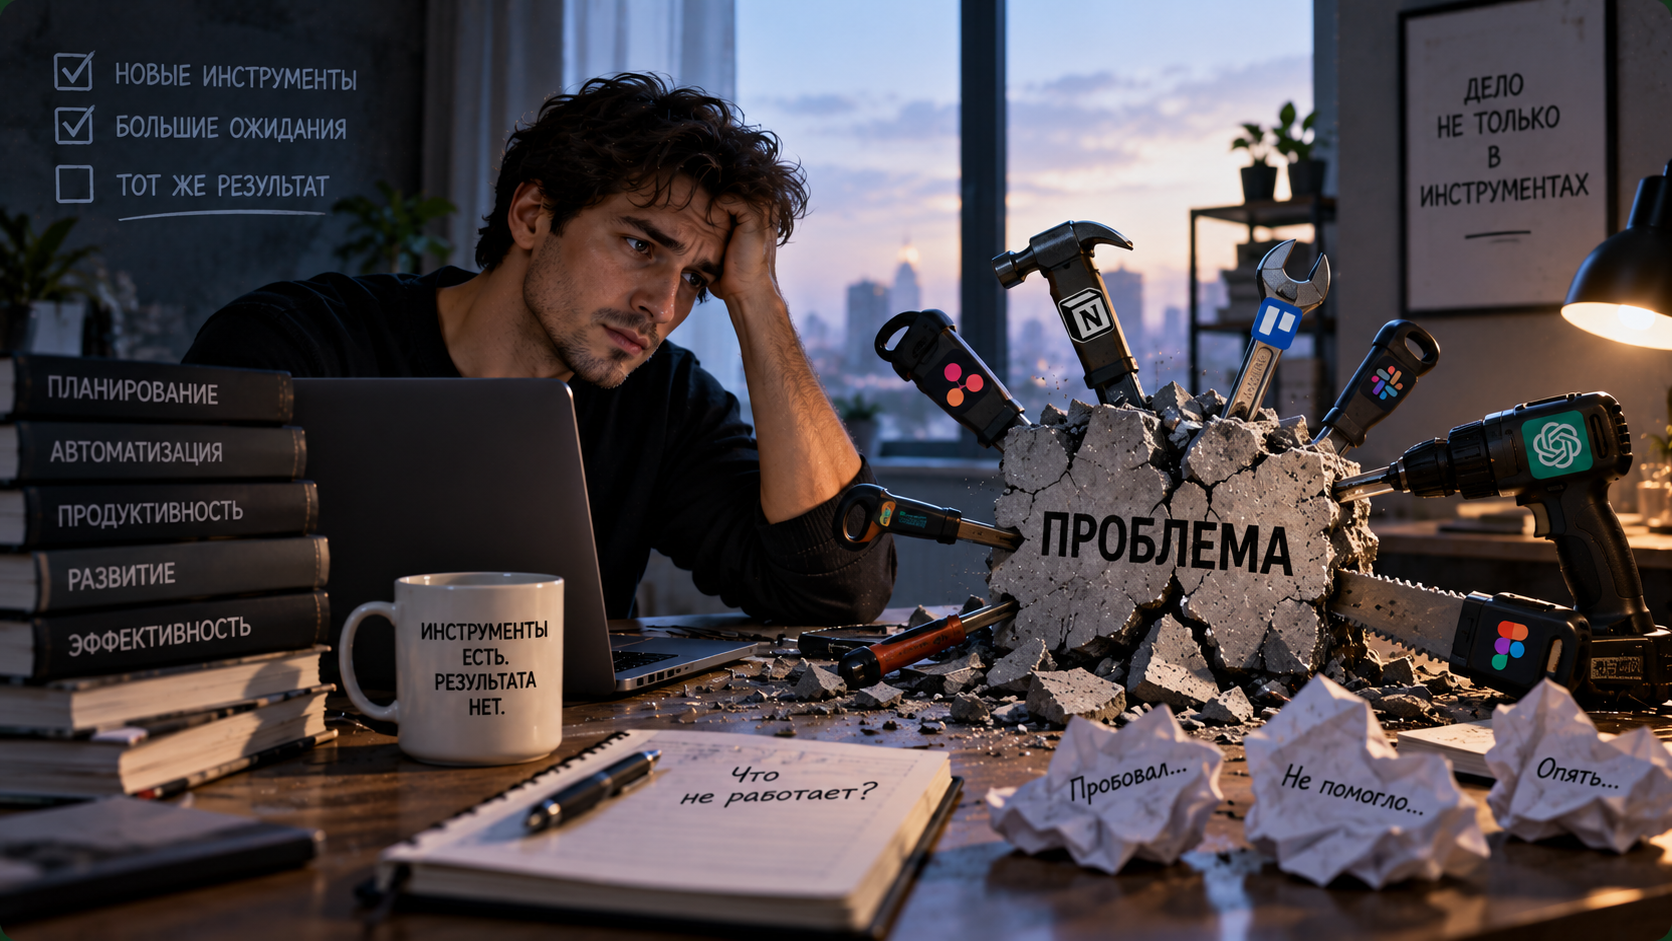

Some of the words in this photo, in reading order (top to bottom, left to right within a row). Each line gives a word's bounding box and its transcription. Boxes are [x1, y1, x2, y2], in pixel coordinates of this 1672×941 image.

[115, 62, 191, 86] НОВЫЕ
[203, 65, 357, 91] ИНСТРУМЕНТЫ
[1464, 73, 1524, 105] ДЕЛО
[116, 115, 219, 139] БОЛЬШИЕ
[229, 117, 347, 143] ОЖИДАНИЯ
[1437, 113, 1464, 139] НЕ
[1473, 105, 1561, 135] ТОЛЬКО
[1487, 145, 1502, 169] В
[116, 173, 162, 197] ТОТ
[172, 174, 206, 197] ЖЕ
[217, 174, 331, 198] РЕЗУЛЬТАТ
[1420, 172, 1589, 208] ИНСТРУМЕНТАХ
[1079, 303, 1104, 332] N
[48, 375, 219, 405] ПЛАНИРОВАНИЕ
[50, 440, 223, 466] АВТОМАТИЗАЦИЯ
[58, 500, 244, 529] ПРОДУКТИВНОСТЬ
[1041, 511, 1294, 576] ПРОБЛЕМА
[67, 562, 176, 591] РАЗВИТИЕ
[68, 616, 251, 657] ЭФФЕКТИВНОСТЬ
[421, 620, 548, 641] ИНСТРУМЕНТЫ
[462, 648, 509, 666] ЕСТЬ.
[435, 671, 537, 691] РЕЗУЛЬТАТА
[469, 697, 505, 716] НЕТ.
[731, 766, 780, 783] Что
[1070, 763, 1187, 805] Пробовал...
[1537, 757, 1619, 789] Опять...
[680, 792, 715, 805] не
[724, 781, 879, 808] работает?
[1281, 763, 1312, 790] Не
[1319, 780, 1423, 816] помогло...
